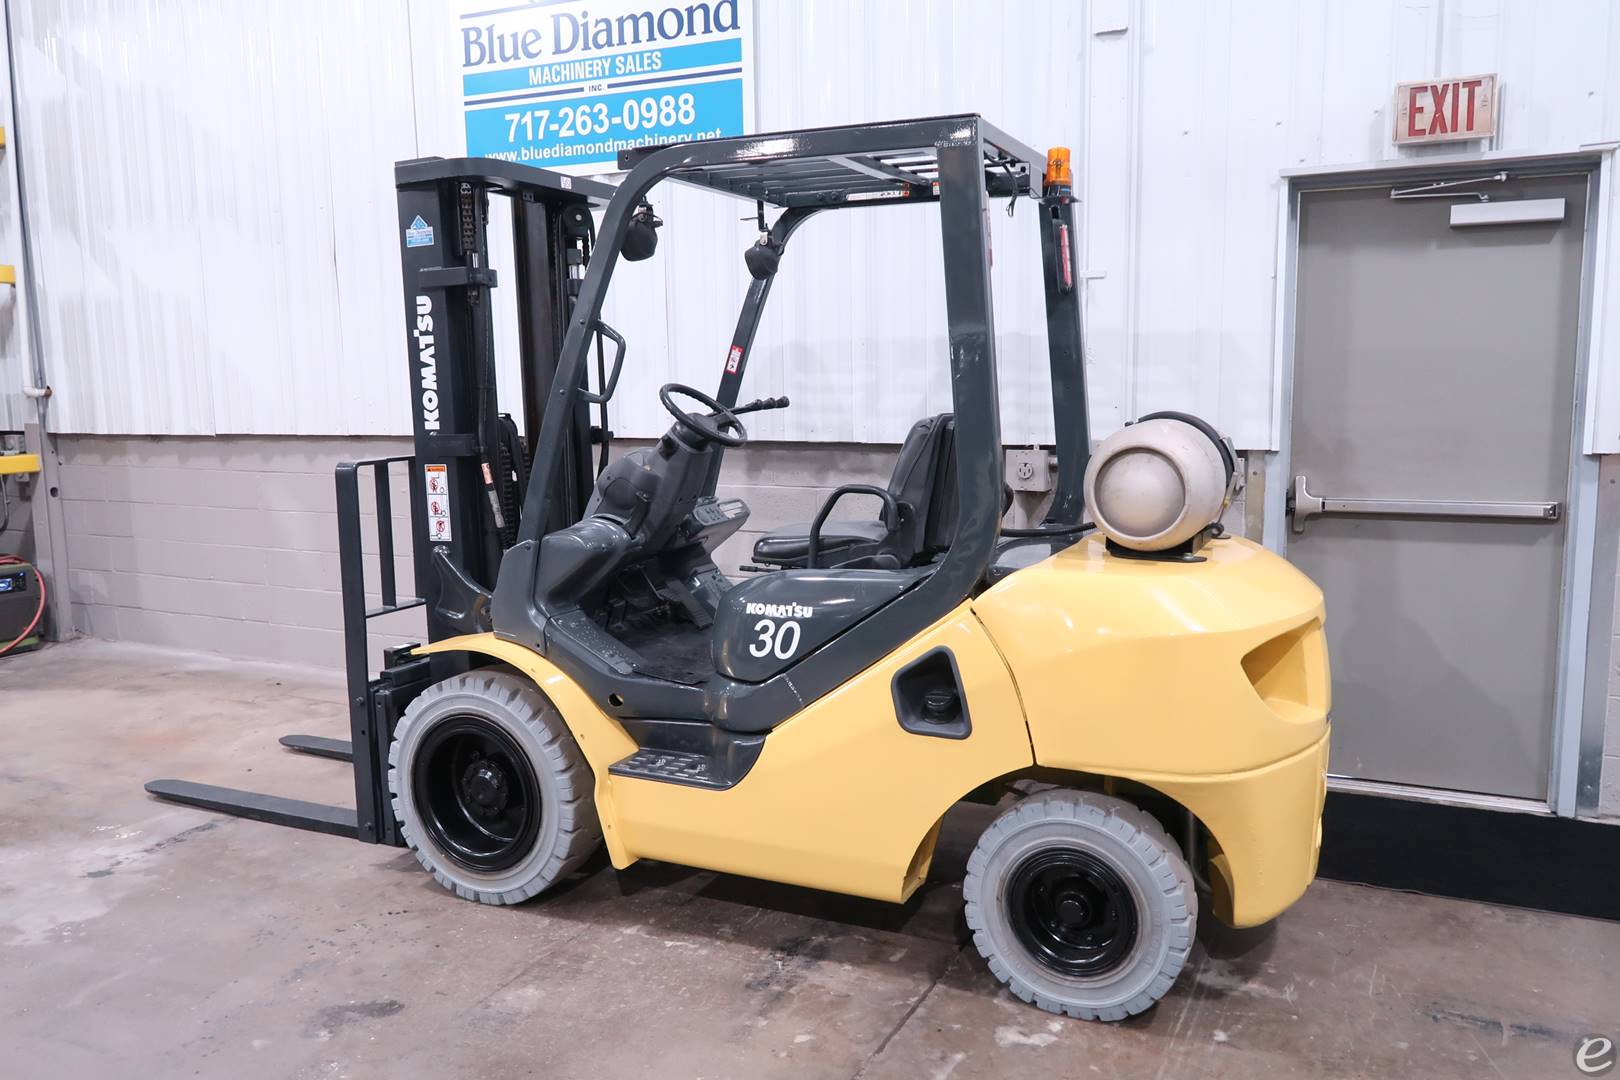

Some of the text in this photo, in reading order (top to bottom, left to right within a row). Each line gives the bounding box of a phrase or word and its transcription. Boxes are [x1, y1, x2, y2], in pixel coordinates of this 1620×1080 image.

[461, 0, 740, 67] Blue Diamond
[528, 51, 662, 86] MACHINERY SALES
[504, 93, 697, 143] 717-263-0988
[1408, 80, 1482, 137] EXIT
[485, 128, 721, 161] ww.bluediamondmachinerynet
[414, 296, 440, 430] KOMATSU
[745, 602, 814, 618] KOMATSU
[749, 619, 801, 660] 30
